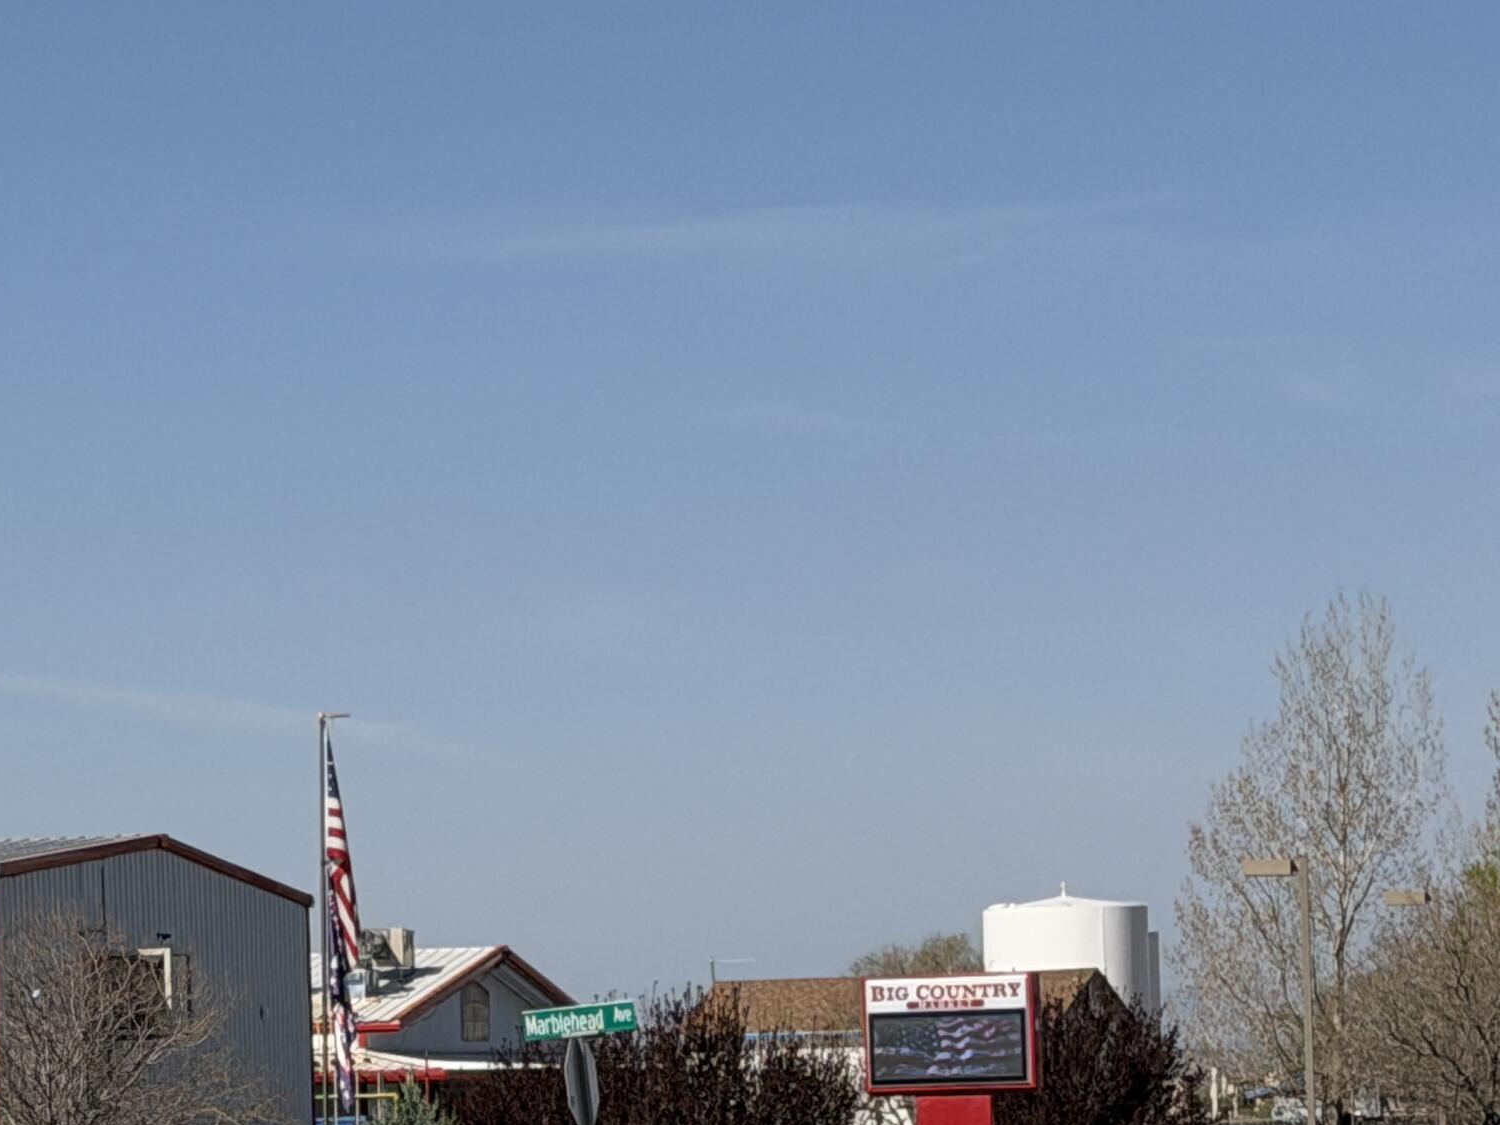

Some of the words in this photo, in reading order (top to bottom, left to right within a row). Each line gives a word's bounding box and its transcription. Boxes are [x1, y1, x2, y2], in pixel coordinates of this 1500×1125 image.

[870, 985, 909, 1002] BIG
[916, 982, 1021, 1000] COUNTRY
[524, 1009, 605, 1036] Marblehead
[613, 1006, 632, 1023] Ave
